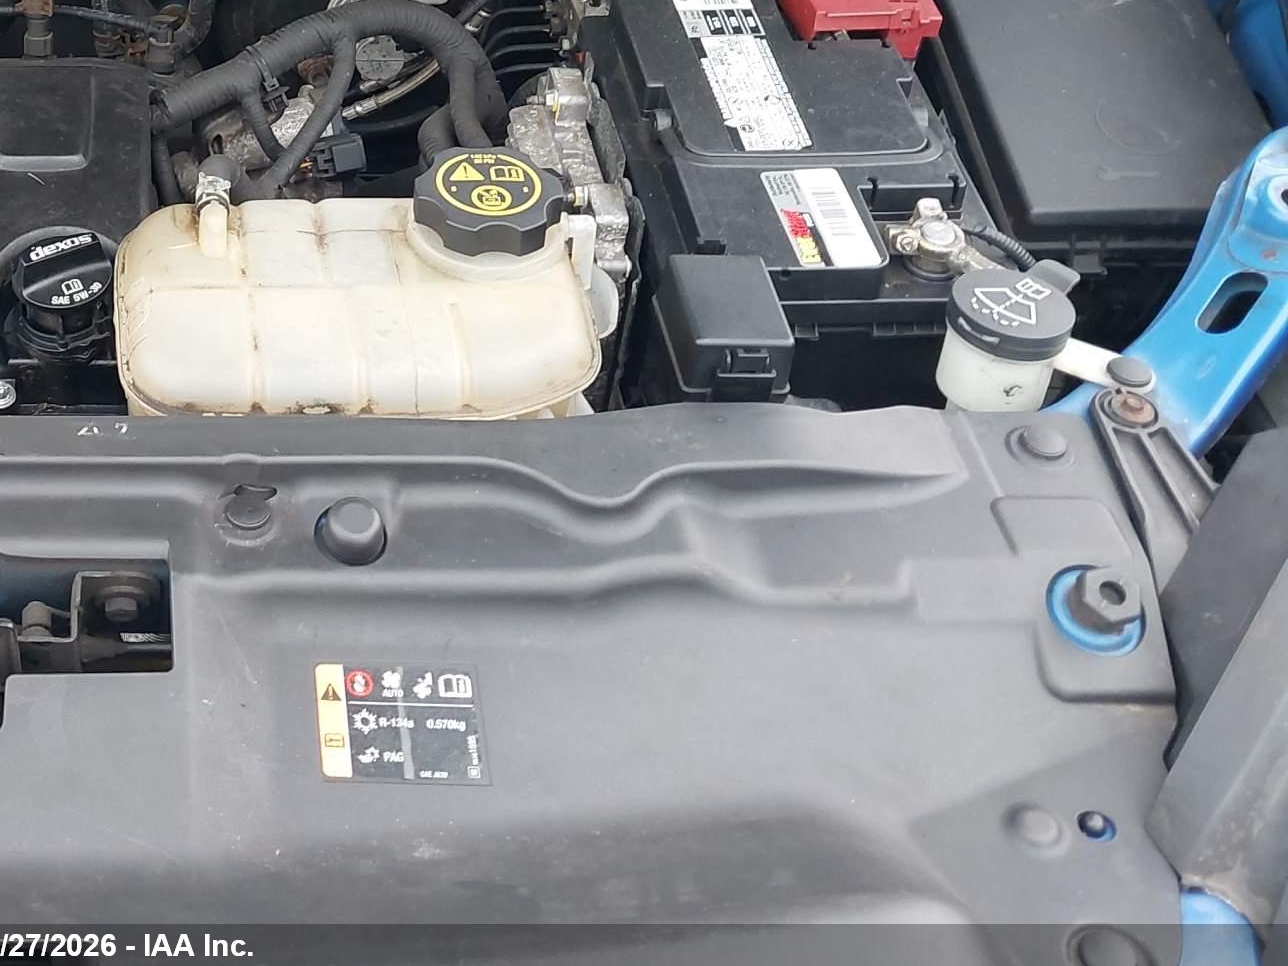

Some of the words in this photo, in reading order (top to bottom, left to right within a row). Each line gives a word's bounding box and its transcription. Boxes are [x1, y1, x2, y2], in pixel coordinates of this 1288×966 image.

[29, 233, 93, 262] dexos
[50, 295, 71, 305] SAE
[72, 281, 103, 302] 5W-30
[382, 688, 404, 698] AUTO
[378, 717, 415, 729] R-134a
[383, 751, 405, 763] PAG
